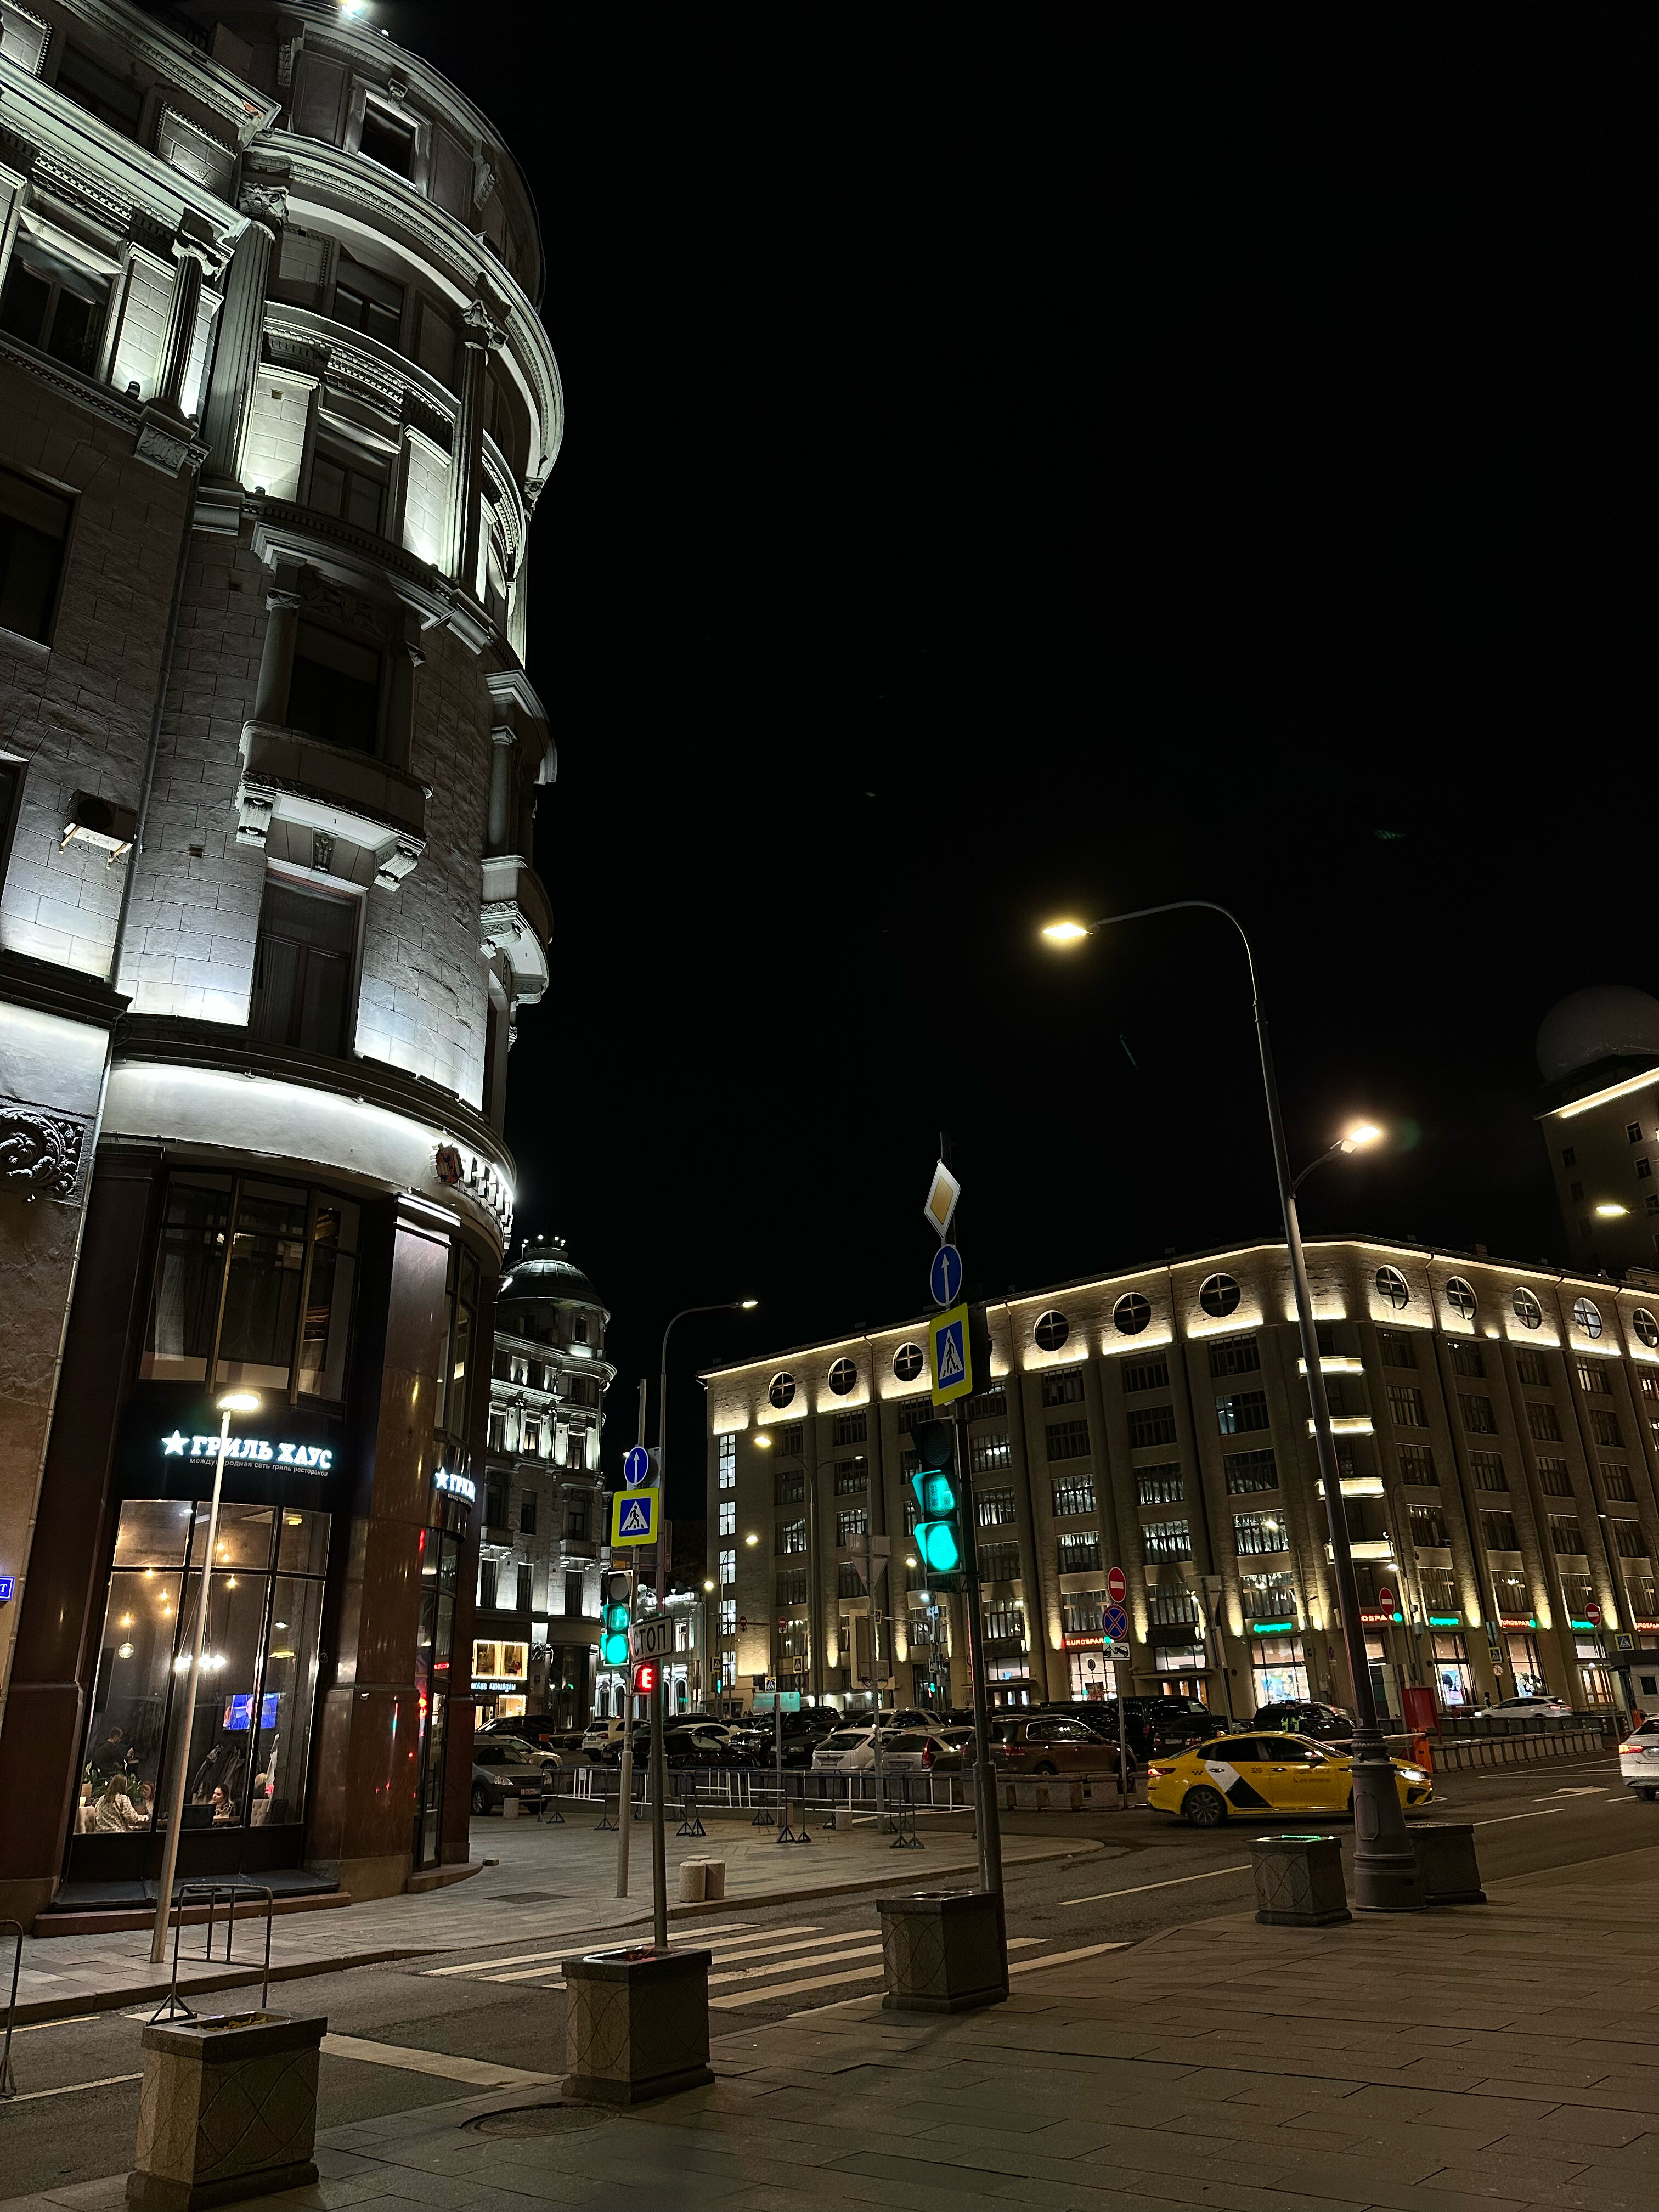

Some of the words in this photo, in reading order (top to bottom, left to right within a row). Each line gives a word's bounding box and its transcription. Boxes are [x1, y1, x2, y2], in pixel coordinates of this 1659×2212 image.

[191, 1436, 273, 1460] ГРИЛЬ
[278, 1443, 332, 1469] ХАУС
[293, 1467, 328, 1477] ресторанов
[633, 1623, 666, 1657] СТОП
[1065, 1637, 1104, 1646] EUROSPAR
